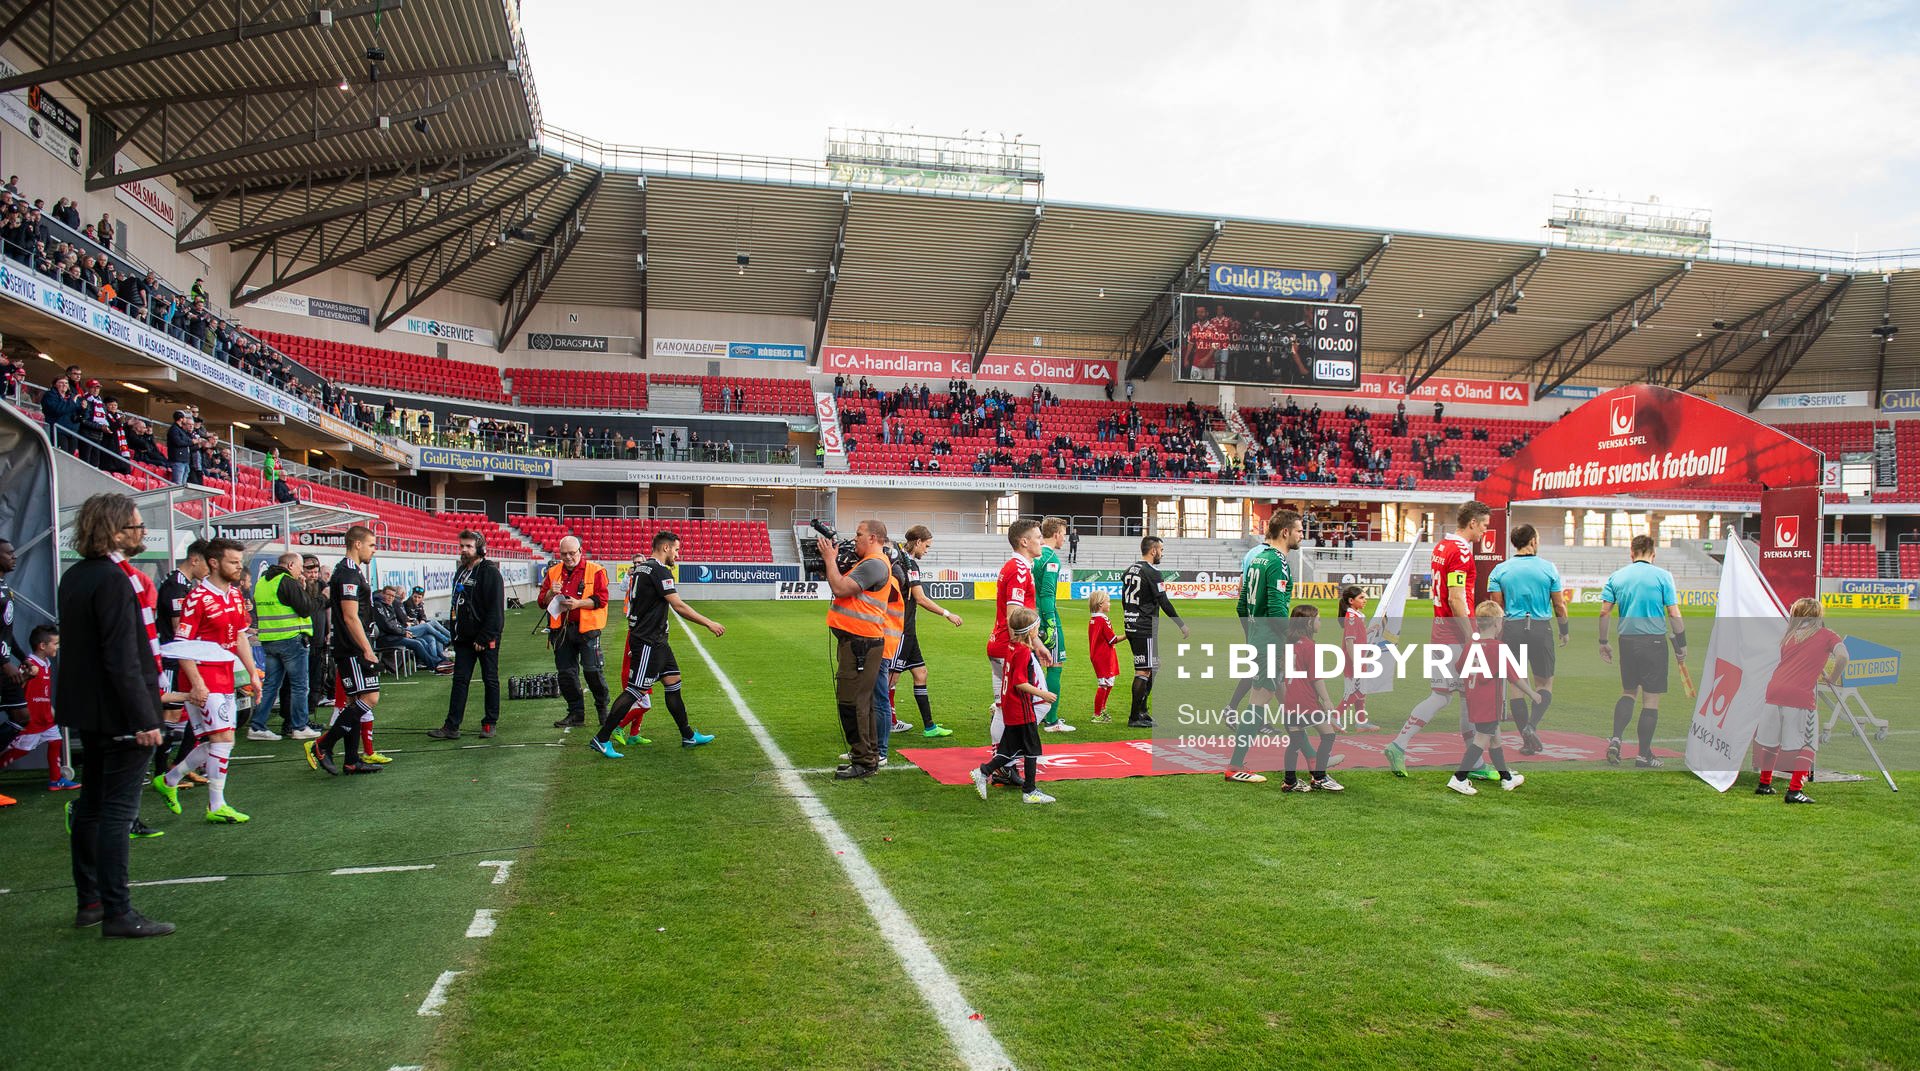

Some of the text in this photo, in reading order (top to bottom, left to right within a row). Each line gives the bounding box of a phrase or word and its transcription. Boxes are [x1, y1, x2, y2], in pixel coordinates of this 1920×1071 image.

[143, 187, 174, 221] SMÅLAND
[9, 273, 36, 300] SERVICE
[1215, 266, 1318, 295] Guld Fågeln
[289, 298, 305, 307] NDC
[311, 300, 339, 312] KALMARS
[339, 305, 367, 317] BREDASTE
[64, 299, 87, 324] SERVICE
[569, 313, 578, 323] N
[407, 318, 475, 342] INFO SERVICE
[1318, 317, 1327, 331] 0
[1345, 318, 1354, 332] 0
[656, 341, 714, 353] KANONADEN
[1318, 337, 1353, 351] 00:00
[829, 353, 943, 373] ICA-handlarna
[951, 359, 1010, 376] Kamar
[1013, 361, 1026, 375] &
[1030, 358, 1075, 379] Öland
[1083, 364, 1110, 380] ICA
[1318, 363, 1351, 377] Liljas
[1388, 382, 1437, 396] Kamar
[1441, 387, 1451, 397] &
[1455, 382, 1492, 399] Öland
[1500, 387, 1522, 400] ICA
[1778, 395, 1846, 407] INFO SERVICE
[1598, 436, 1647, 450] SVENSKA SPEL
[423, 451, 449, 465] Guld
[450, 455, 482, 471] Fågeln
[489, 460, 513, 470] Guld
[514, 461, 544, 474] Fågeln
[1532, 446, 1727, 491] Framåt för svensk fotboll!
[218, 525, 277, 539] hummel
[314, 535, 345, 545] humm
[1764, 550, 1811, 559] SVENSKA SPEL
[715, 567, 781, 583] Lindbytvätten
[1456, 574, 1464, 584] C
[780, 582, 819, 593] HBR
[1165, 583, 1240, 592] PARSONS PARSO
[1846, 582, 1908, 594] Guld Fågeln
[1687, 591, 1720, 606] GROSS
[1824, 594, 1901, 605] YLTE HYLTE
[1847, 660, 1895, 676] CITY GROSS
[1690, 721, 1714, 748] NSKA
